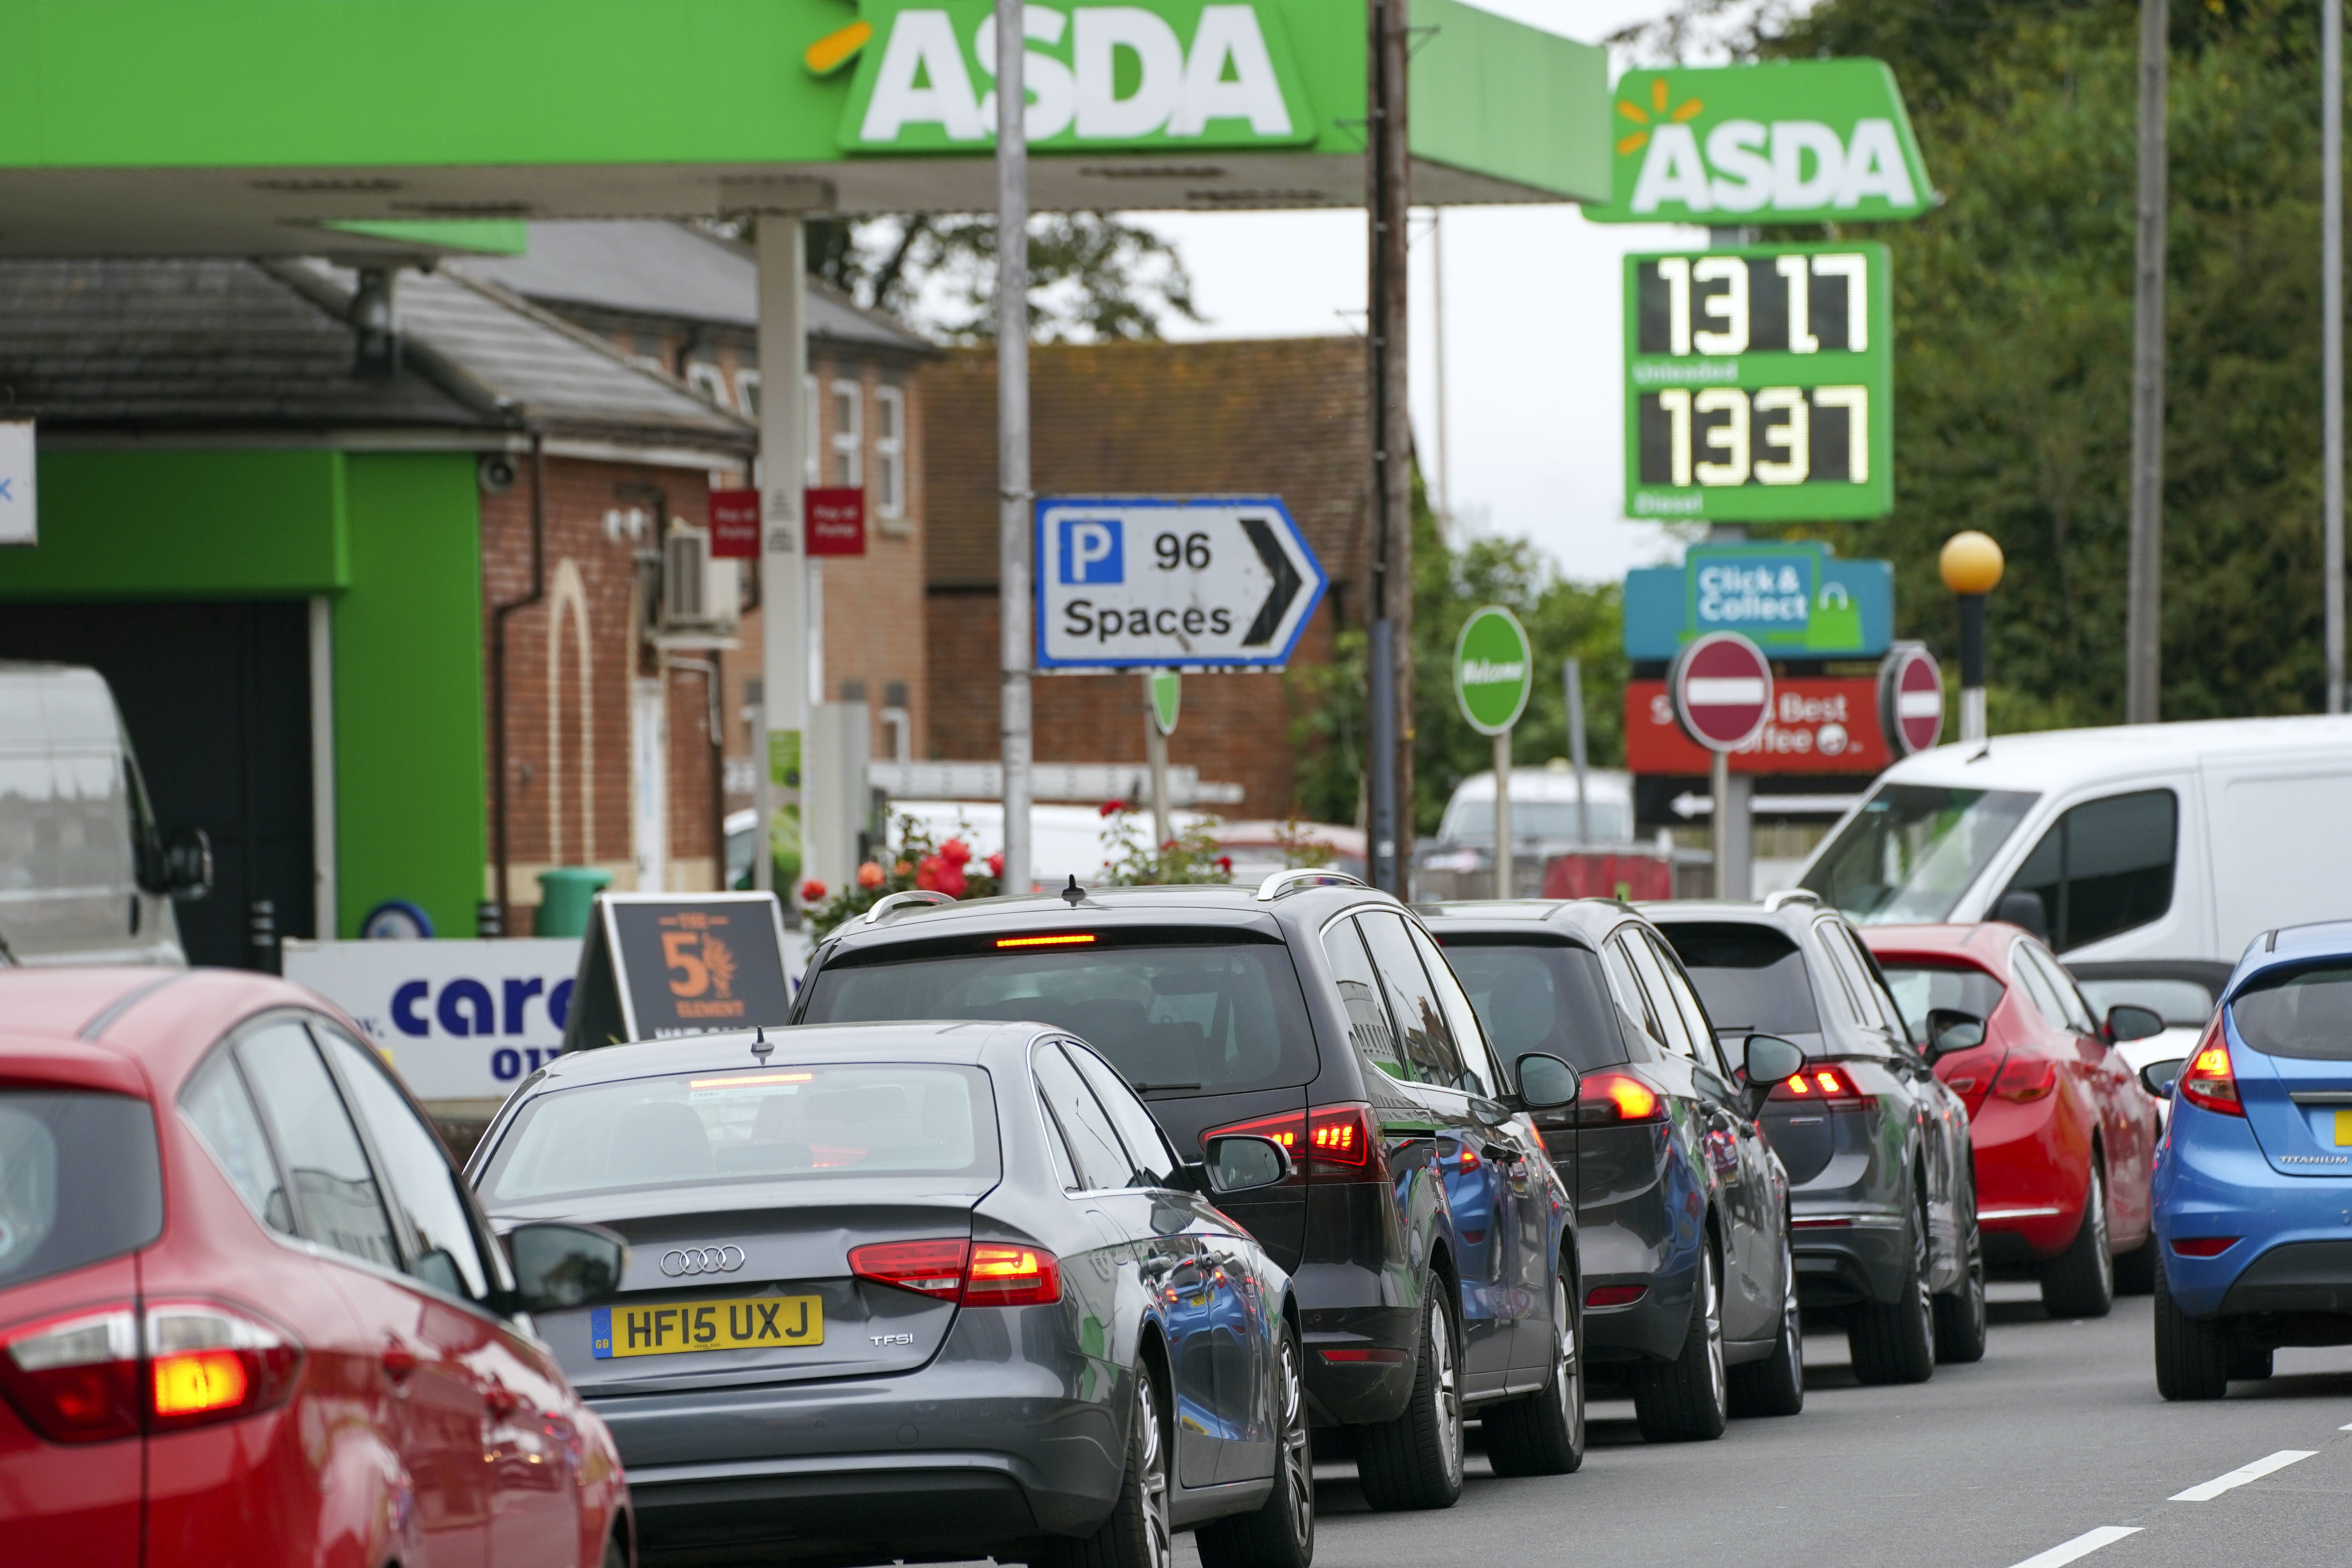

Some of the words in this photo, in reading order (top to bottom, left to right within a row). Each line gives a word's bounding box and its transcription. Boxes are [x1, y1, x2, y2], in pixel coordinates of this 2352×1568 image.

[860, 4, 1294, 142] ASDA
[1630, 118, 1916, 214] ASDA
[1632, 361, 1738, 385] Unleaded
[1634, 491, 1703, 515] Diesel
[1071, 523, 1113, 582] P
[1154, 533, 1210, 570] 96
[1699, 565, 1775, 594] Click
[1778, 565, 1800, 593] &
[1064, 600, 1231, 643] Spaces
[1699, 593, 1808, 621] Collect
[1780, 692, 1848, 722] Best
[661, 931, 709, 997] 5
[675, 1000, 744, 1018] ELEMENT
[2279, 1156, 2348, 1164] TITANIUM
[628, 1307, 717, 1348] HF15
[730, 1302, 808, 1340] UXJ
[870, 1333, 913, 1346] TFSI
[596, 1339, 609, 1349] GB
